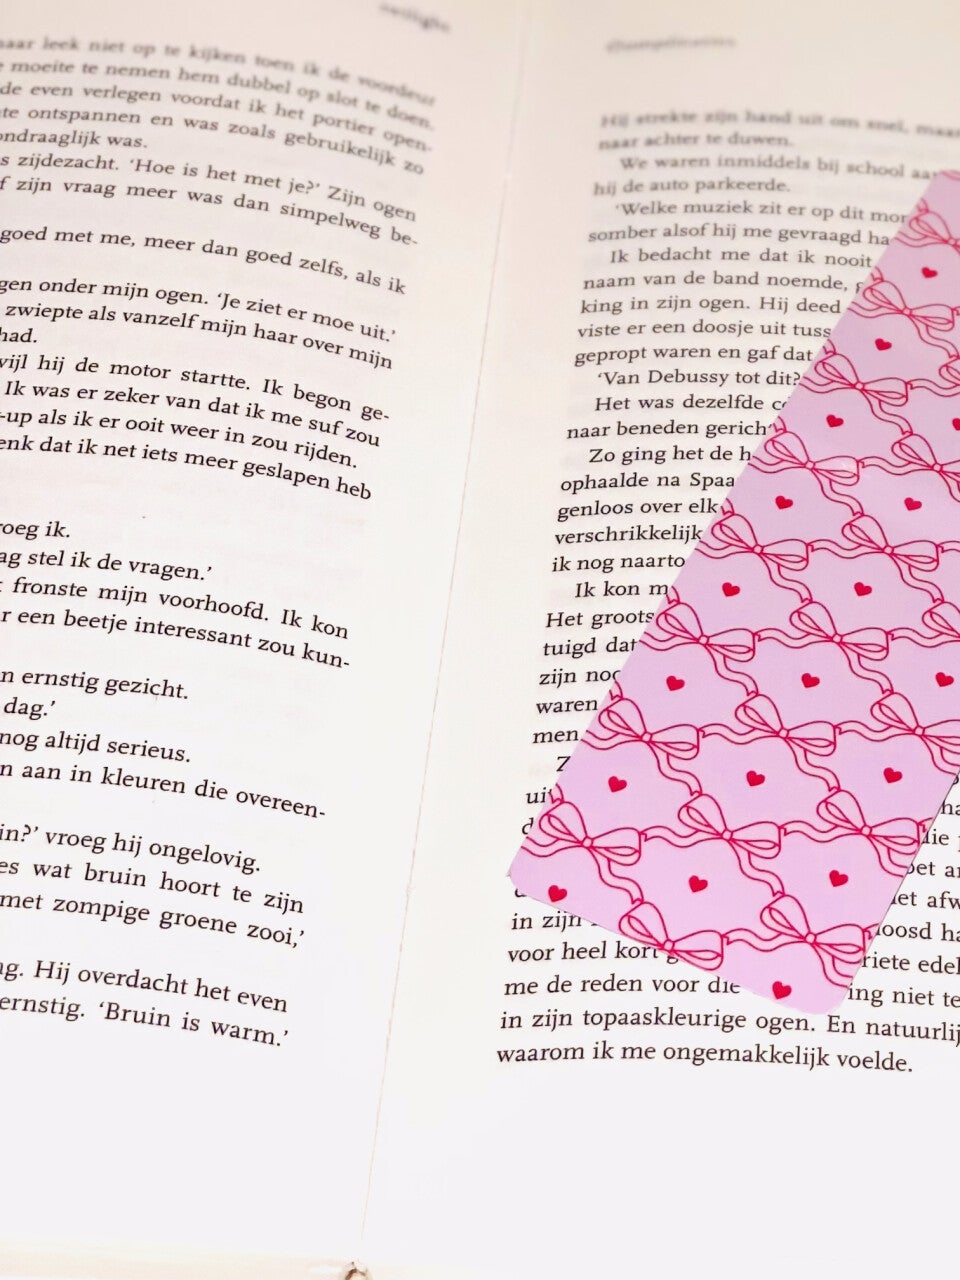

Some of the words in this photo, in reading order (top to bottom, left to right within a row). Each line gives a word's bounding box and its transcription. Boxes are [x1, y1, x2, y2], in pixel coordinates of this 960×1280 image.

[42, 36, 79, 51] leek
[88, 41, 126, 53] niet
[132, 44, 157, 59] op
[164, 44, 181, 57] te
[188, 45, 247, 65] kijken
[254, 55, 295, 73] toen
[302, 63, 320, 76] ik
[327, 66, 351, 83] de
[357, 76, 436, 107] voordeur
[27, 108, 141, 125] ontspannen
[150, 115, 174, 127] en
[183, 118, 219, 131] was
[227, 123, 276, 140] zoals
[283, 131, 395, 166] gebruikelijk
[403, 160, 425, 176] zo
[597, 137, 639, 151] naar
[643, 132, 701, 147] achter
[705, 133, 723, 145] te
[726, 131, 793, 148] duwen.
[17, 152, 119, 171] zijdezacht.
[182, 162, 199, 177] is
[206, 164, 237, 182] het
[243, 174, 282, 189] met
[327, 185, 365, 208] Zijn
[372, 201, 416, 222] ogen
[592, 181, 617, 197] hij
[622, 178, 645, 194] de
[649, 179, 690, 192] auto
[694, 176, 791, 195] parkeerde.
[683, 199, 753, 214] muziek
[759, 201, 782, 215] zit
[786, 205, 807, 216] er
[810, 207, 835, 222] op
[839, 205, 864, 221] dit
[0, 225, 48, 244] goed
[54, 230, 94, 243] met
[99, 233, 136, 248] me,
[143, 237, 196, 252] meer
[201, 239, 238, 257] dan
[245, 249, 293, 267] goed
[298, 258, 348, 280] zelfs,
[355, 269, 382, 287] als
[387, 276, 406, 295] ik
[38, 277, 98, 294] onder
[101, 282, 149, 301] mijn
[155, 289, 209, 306] ogen.
[245, 298, 283, 316] ziet
[287, 308, 308, 321] er
[312, 313, 355, 332] moe
[580, 299, 623, 316] king
[630, 296, 649, 311] in
[656, 295, 692, 313] zijn
[698, 298, 751, 313] ogen.
[759, 296, 789, 315] Hij
[796, 297, 842, 314] deed
[594, 396, 631, 412] Het
[637, 398, 674, 409] was
[682, 393, 765, 410] dezelfde
[560, 471, 650, 496] ophaalde
[656, 475, 681, 487] na
[27, 549, 65, 567] stel
[70, 550, 92, 569] ik
[96, 552, 123, 571] de
[17, 611, 55, 625] een
[63, 608, 128, 635] beetje
[133, 616, 253, 648] interessant
[257, 638, 295, 657] zou
[301, 642, 350, 669] kun-
[21, 671, 100, 695] ernstig
[104, 677, 188, 700] gezicht.
[0, 732, 40, 752] nog
[44, 730, 101, 756] altijd
[106, 739, 190, 763] serieus.
[45, 831, 107, 855] vroeg
[111, 832, 143, 858] hij
[148, 842, 260, 876] ongelovig.
[33, 863, 73, 879] wat
[84, 862, 146, 888] bruin
[158, 870, 221, 898] hoort
[232, 885, 252, 903] te
[263, 891, 304, 916] zijn
[503, 981, 539, 996] me
[546, 974, 573, 994] de
[580, 972, 643, 993] reden
[651, 979, 700, 993] voor
[181, 1011, 201, 1032] is
[500, 1011, 523, 1029] in
[531, 1008, 573, 1032] zijn
[582, 1006, 747, 1034] topaaskleurige
[755, 1015, 815, 1036] ogen.
[826, 1014, 856, 1034] En
[496, 1046, 585, 1063] waarom
[592, 1039, 615, 1060] ik
[620, 1046, 657, 1060] me
[663, 1043, 830, 1072] ongemakkelijk
[836, 1050, 913, 1073] voelde.
